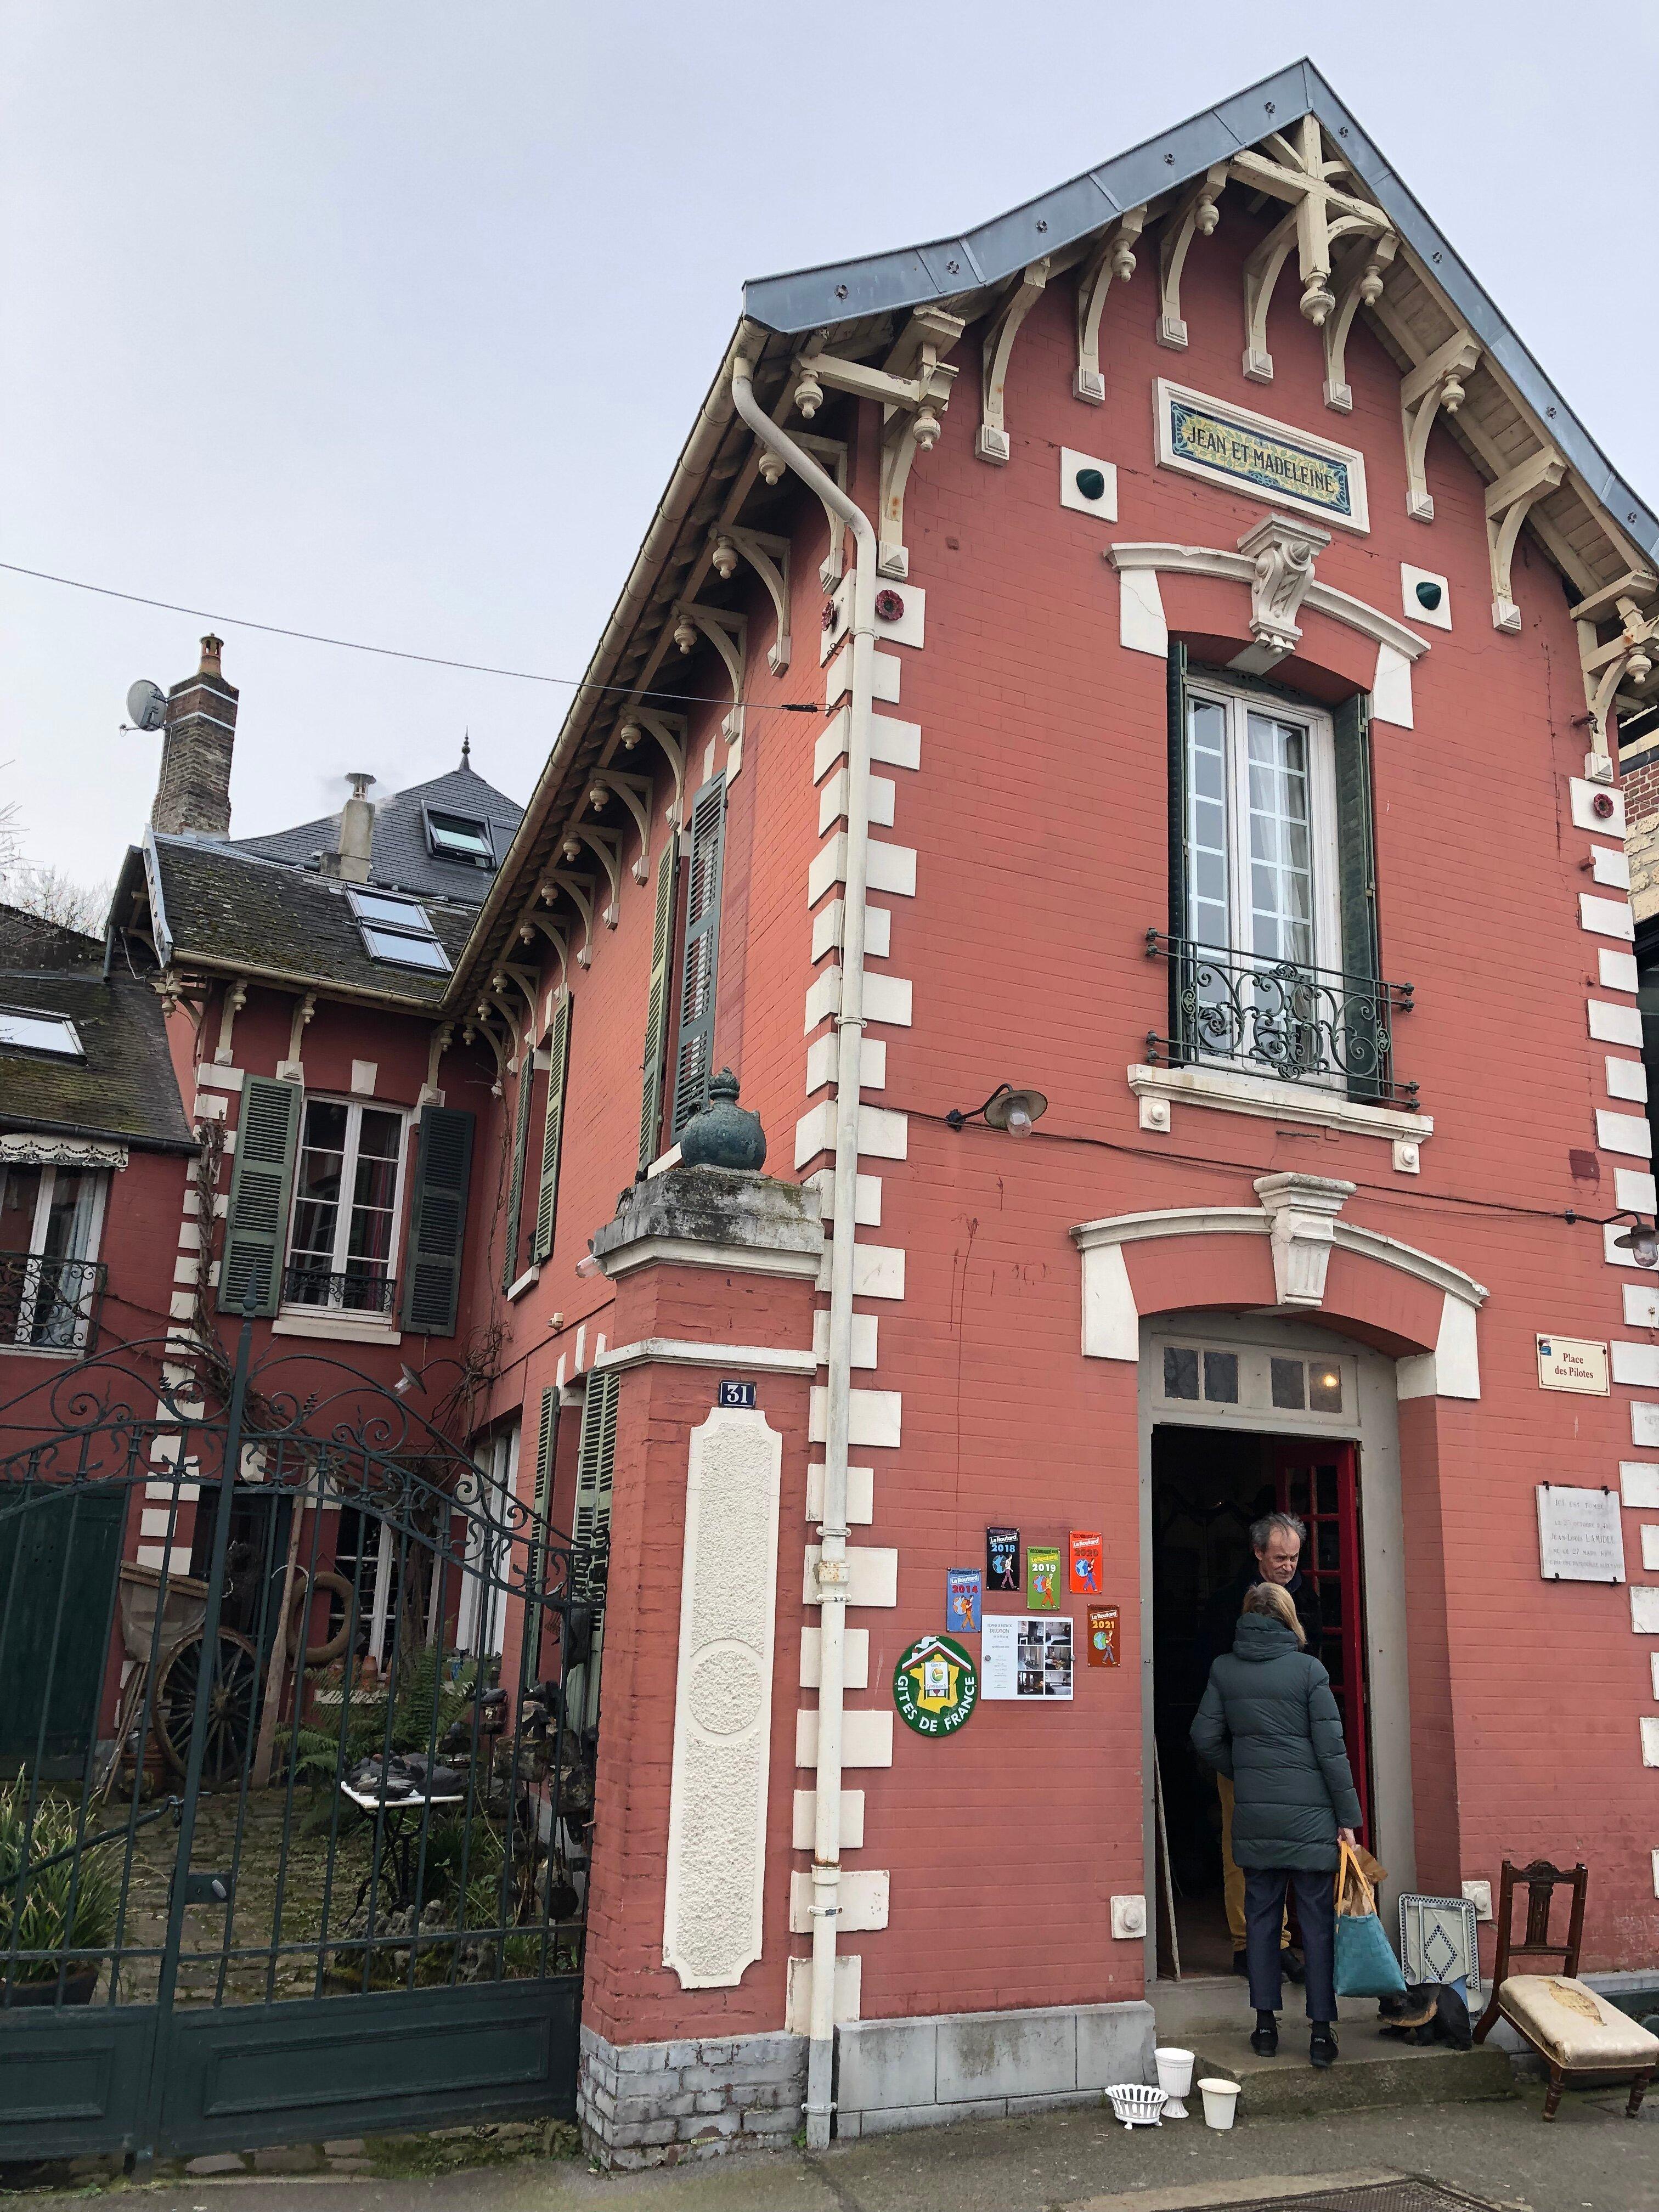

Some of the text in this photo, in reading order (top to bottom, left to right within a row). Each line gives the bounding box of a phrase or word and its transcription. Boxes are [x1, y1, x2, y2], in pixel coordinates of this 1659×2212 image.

[1187, 426, 1334, 493] JEAN ET MADELEINE
[1563, 1353, 1584, 1364] Place
[1555, 1365, 1594, 1379] des Pilotes
[727, 1385, 748, 1403] 31
[991, 1544, 1015, 1553] 2018
[1032, 1564, 1056, 1572] 2019
[952, 1585, 978, 1593] 2014
[898, 1675, 975, 1732] GITES DE FRANCE
